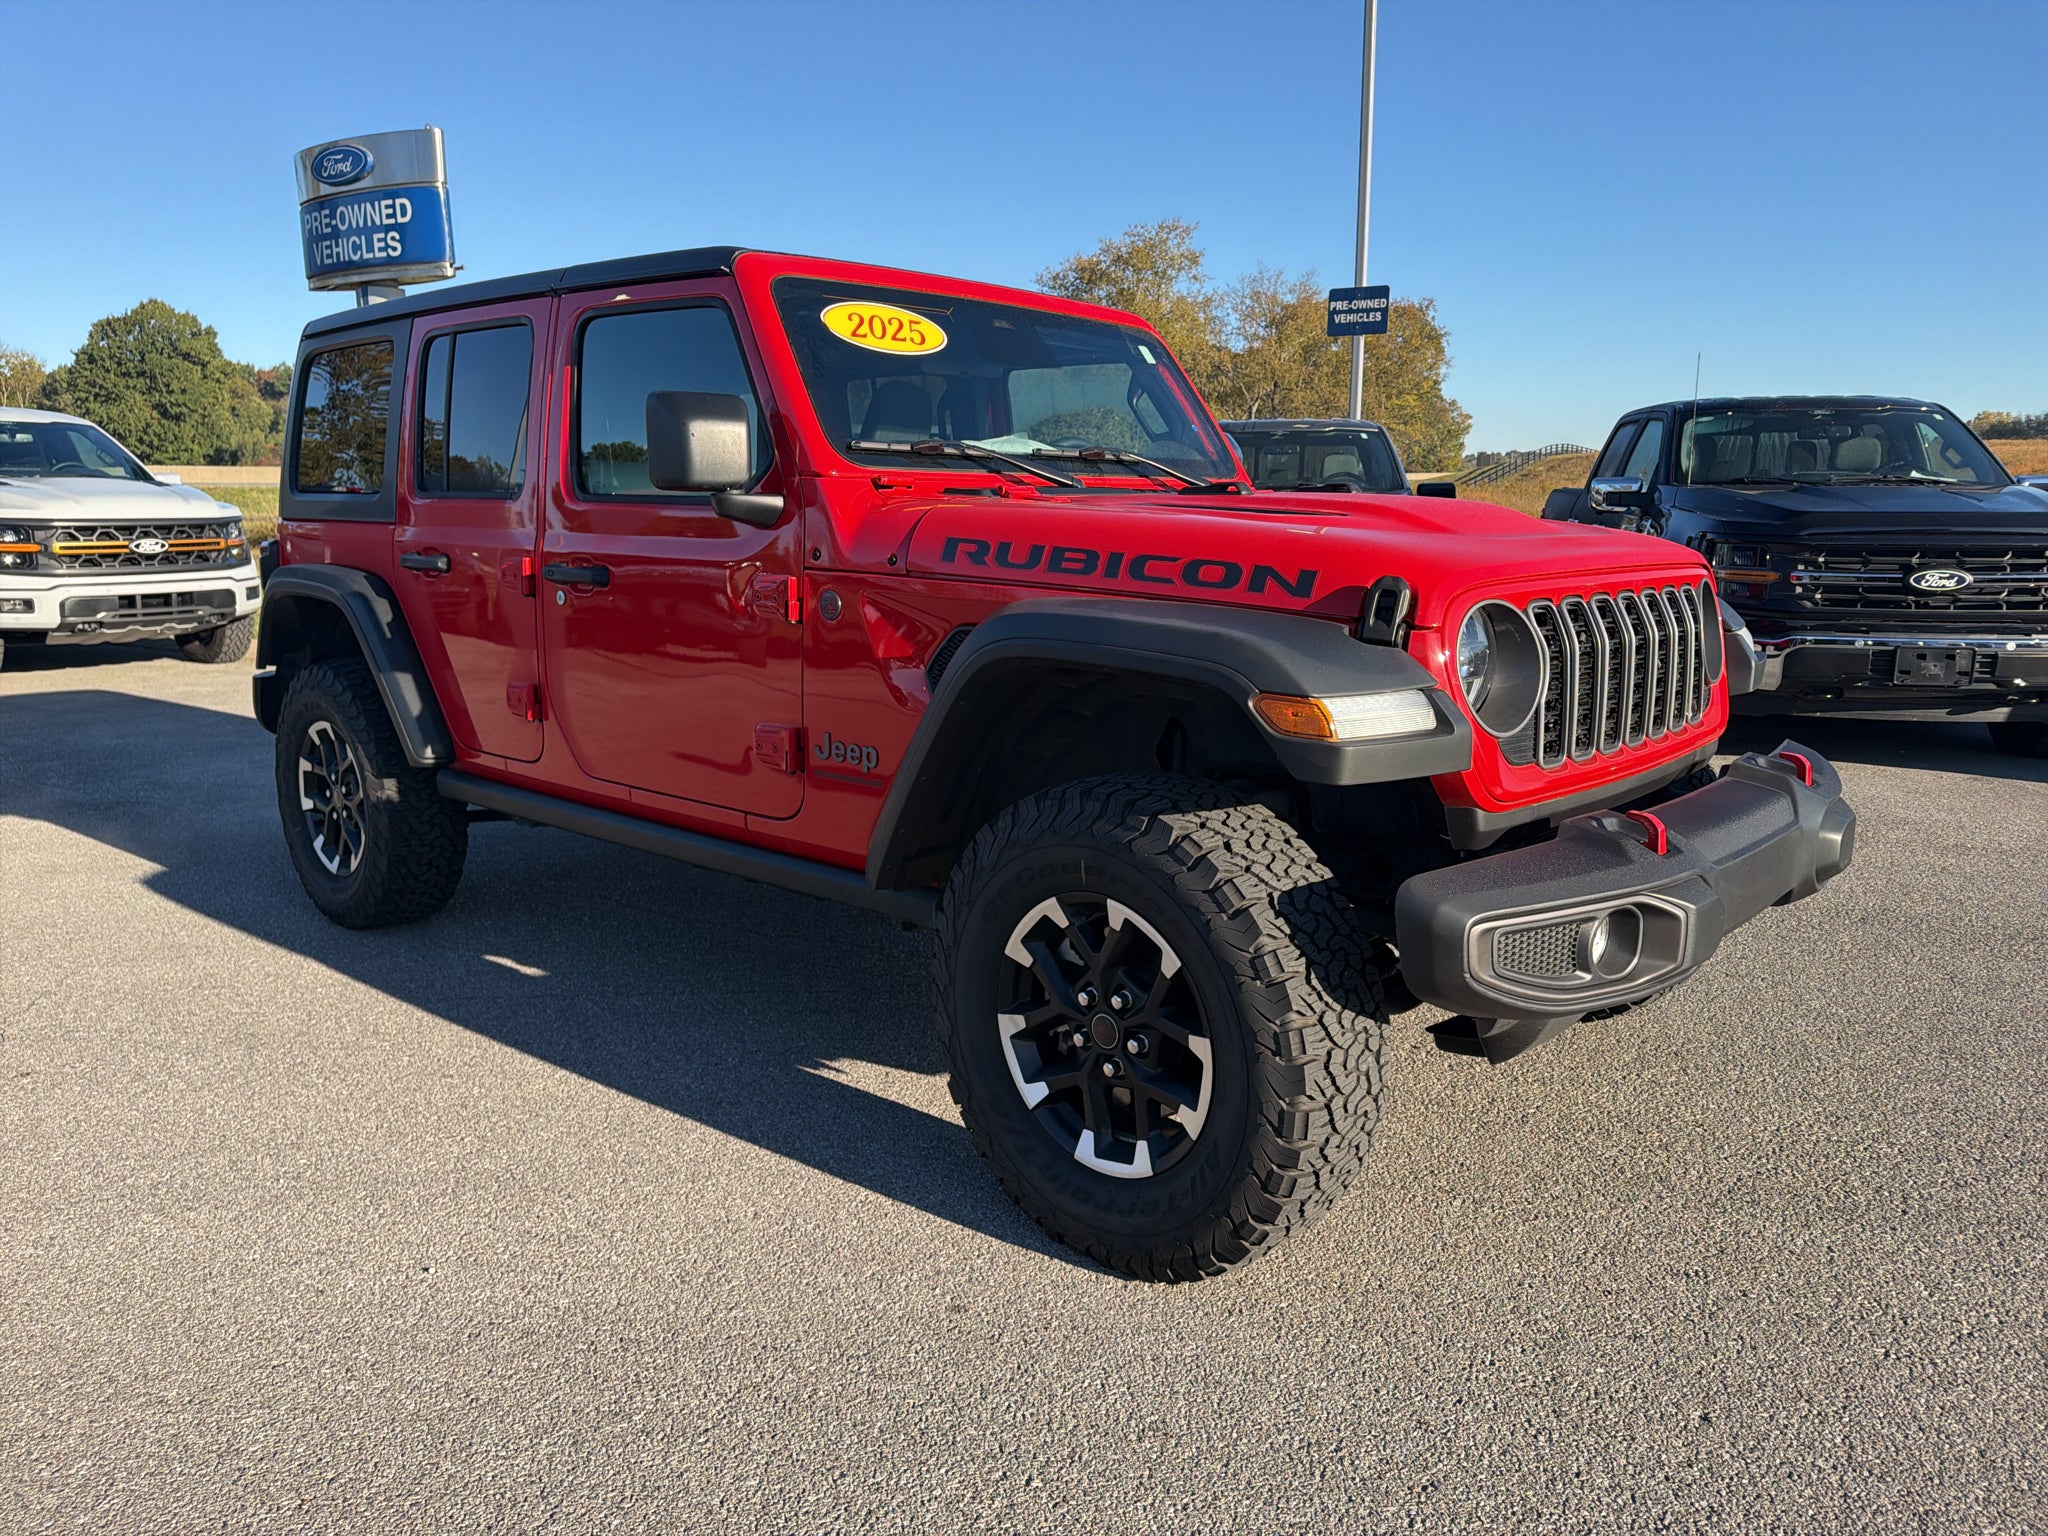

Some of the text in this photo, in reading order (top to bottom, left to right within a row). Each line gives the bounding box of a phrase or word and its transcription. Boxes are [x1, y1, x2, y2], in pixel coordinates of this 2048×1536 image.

[321, 153, 352, 177] Ford
[304, 197, 412, 238] PRE-OWNED
[312, 230, 402, 267] VEHICLES
[1329, 298, 1387, 312] PRE-OWNED
[1333, 311, 1382, 324] VEHICLES
[847, 312, 926, 346] 2025
[940, 536, 1321, 600] RUBICON
[1920, 572, 1959, 587] Ford
[814, 731, 879, 774] Jeep
